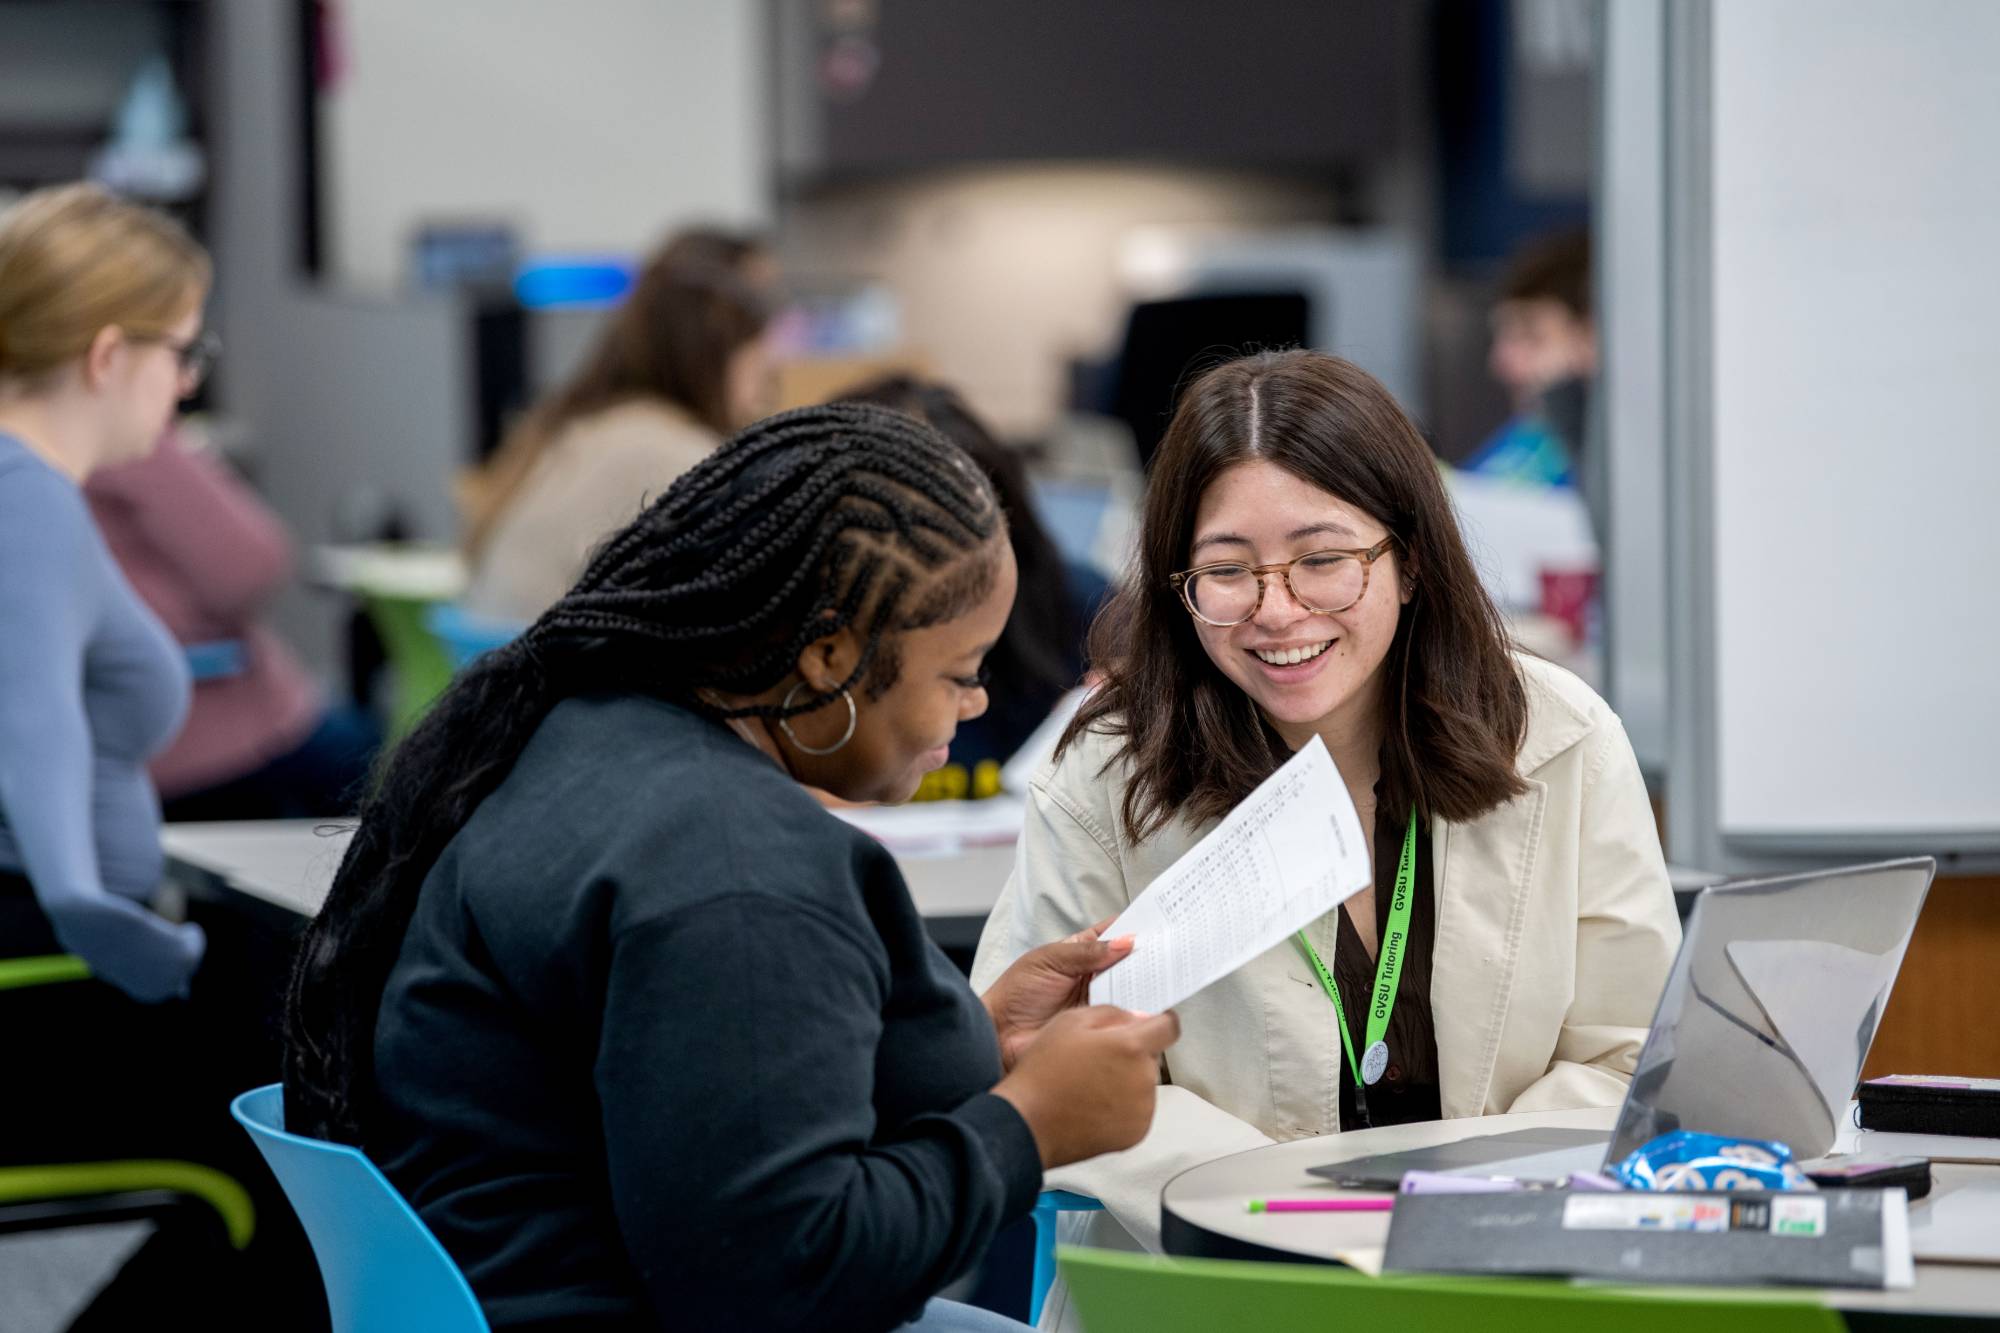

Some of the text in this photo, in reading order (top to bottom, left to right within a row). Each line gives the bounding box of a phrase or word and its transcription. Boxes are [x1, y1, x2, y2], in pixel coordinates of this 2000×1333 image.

[1394, 876, 1408, 911] GVSU
[1375, 931, 1403, 1019] GVSU Tutoring
